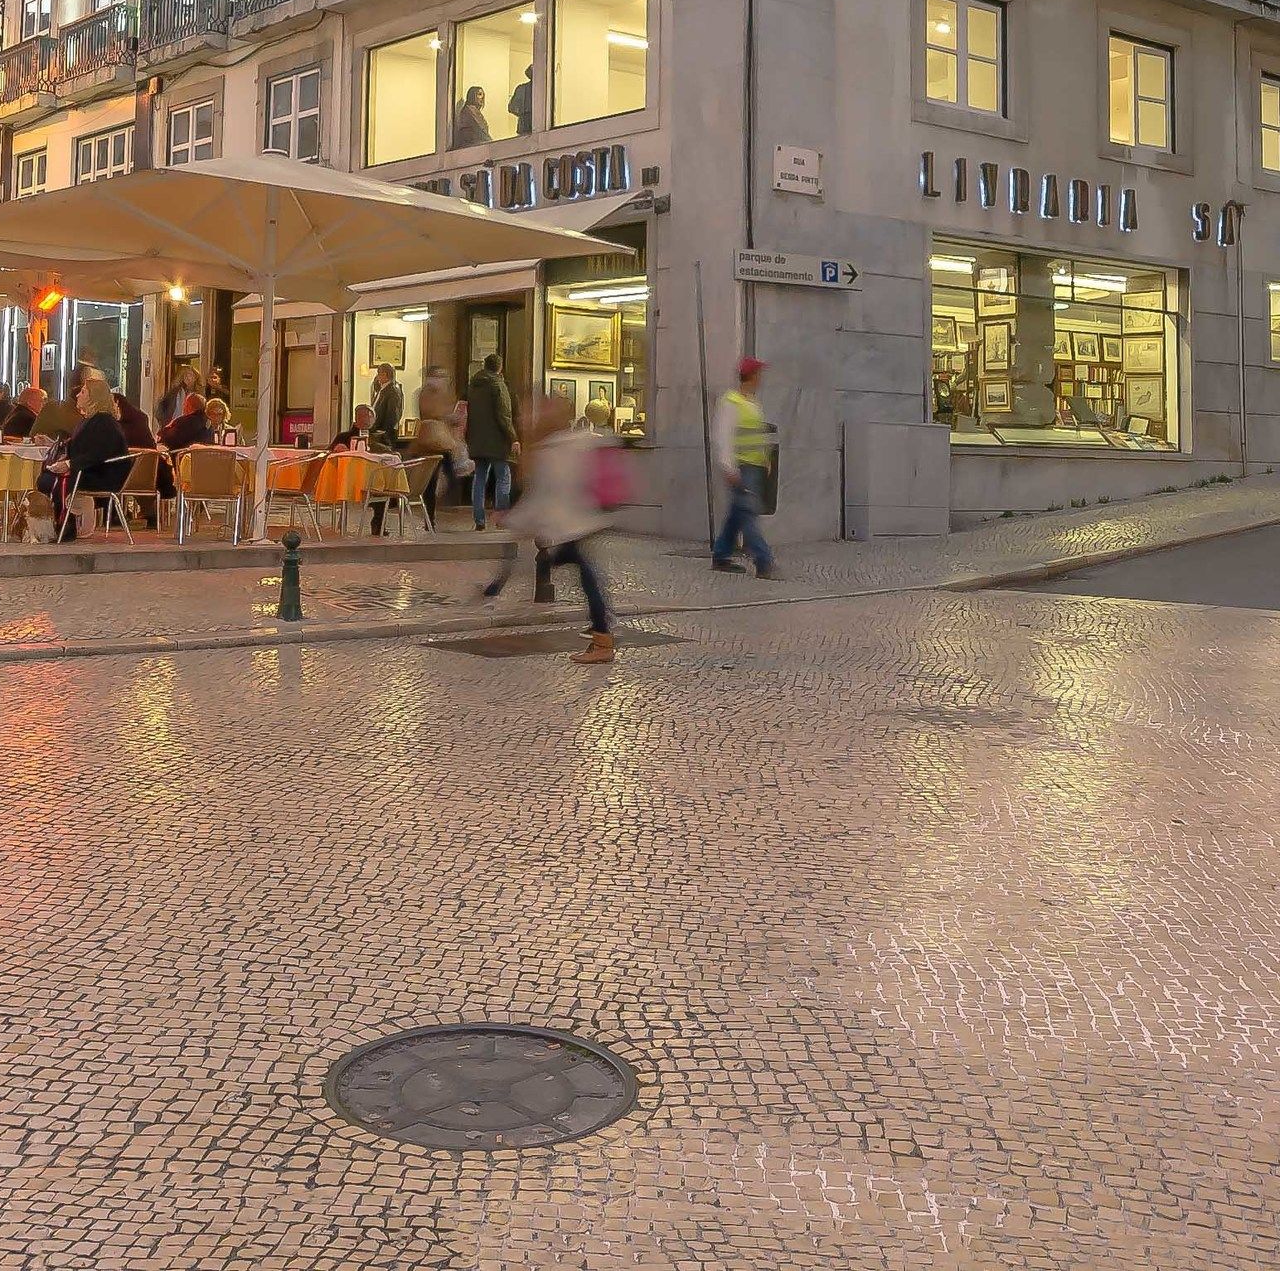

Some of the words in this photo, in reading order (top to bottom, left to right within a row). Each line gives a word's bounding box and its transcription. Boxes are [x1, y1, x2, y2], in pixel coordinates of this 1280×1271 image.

[500, 162, 535, 209] DA
[543, 144, 630, 200] COSTA
[920, 151, 1138, 232] LIVRARIA
[739, 252, 772, 264] parque
[774, 254, 786, 264] de
[739, 267, 814, 282] estacionamento
[825, 265, 836, 281] P
